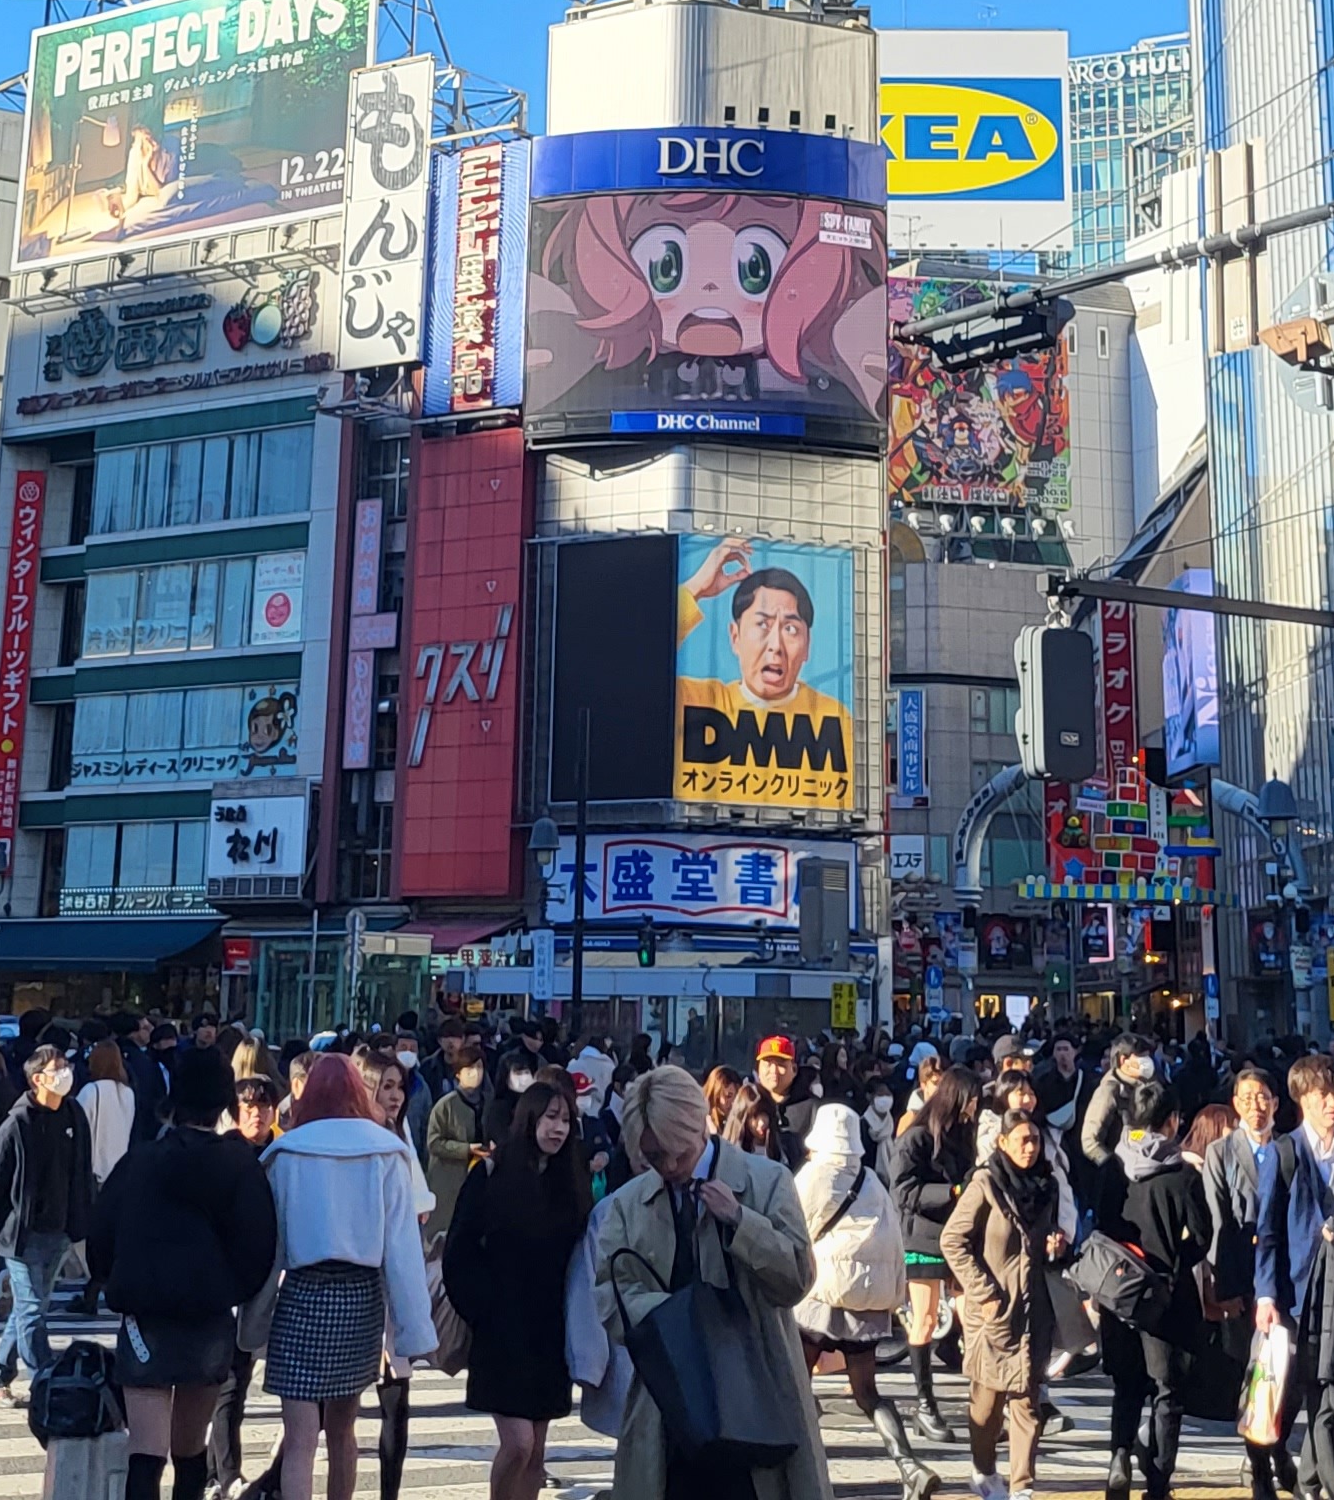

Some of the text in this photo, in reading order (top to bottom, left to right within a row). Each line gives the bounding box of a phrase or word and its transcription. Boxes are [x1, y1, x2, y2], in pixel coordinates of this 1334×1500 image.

[54, 6, 227, 98] PERFECT
[88, 87, 131, 111] 役所広司
[131, 82, 154, 103] 主演
[280, 147, 345, 187] 12.22
[656, 136, 765, 178] DHC
[281, 180, 344, 200] IN THEATERS
[345, 70, 425, 356] もんじゃ
[451, 152, 492, 397] 三千里薬品
[115, 313, 207, 371] 西村
[657, 414, 761, 433] DHC Channel
[1103, 600, 1132, 726] カラオケ
[407, 603, 514, 767] クスリ
[682, 706, 847, 774] DMM
[903, 696, 920, 792] 大盛堂商事ビル
[71, 754, 239, 779] ジャスミンレディースクリニック
[680, 766, 849, 800] オンラインクリニック
[226, 827, 278, 864] 松川
[893, 852, 923, 868] エステ
[559, 848, 801, 908] 大盛堂書
[62, 894, 109, 909] 渋谷西村
